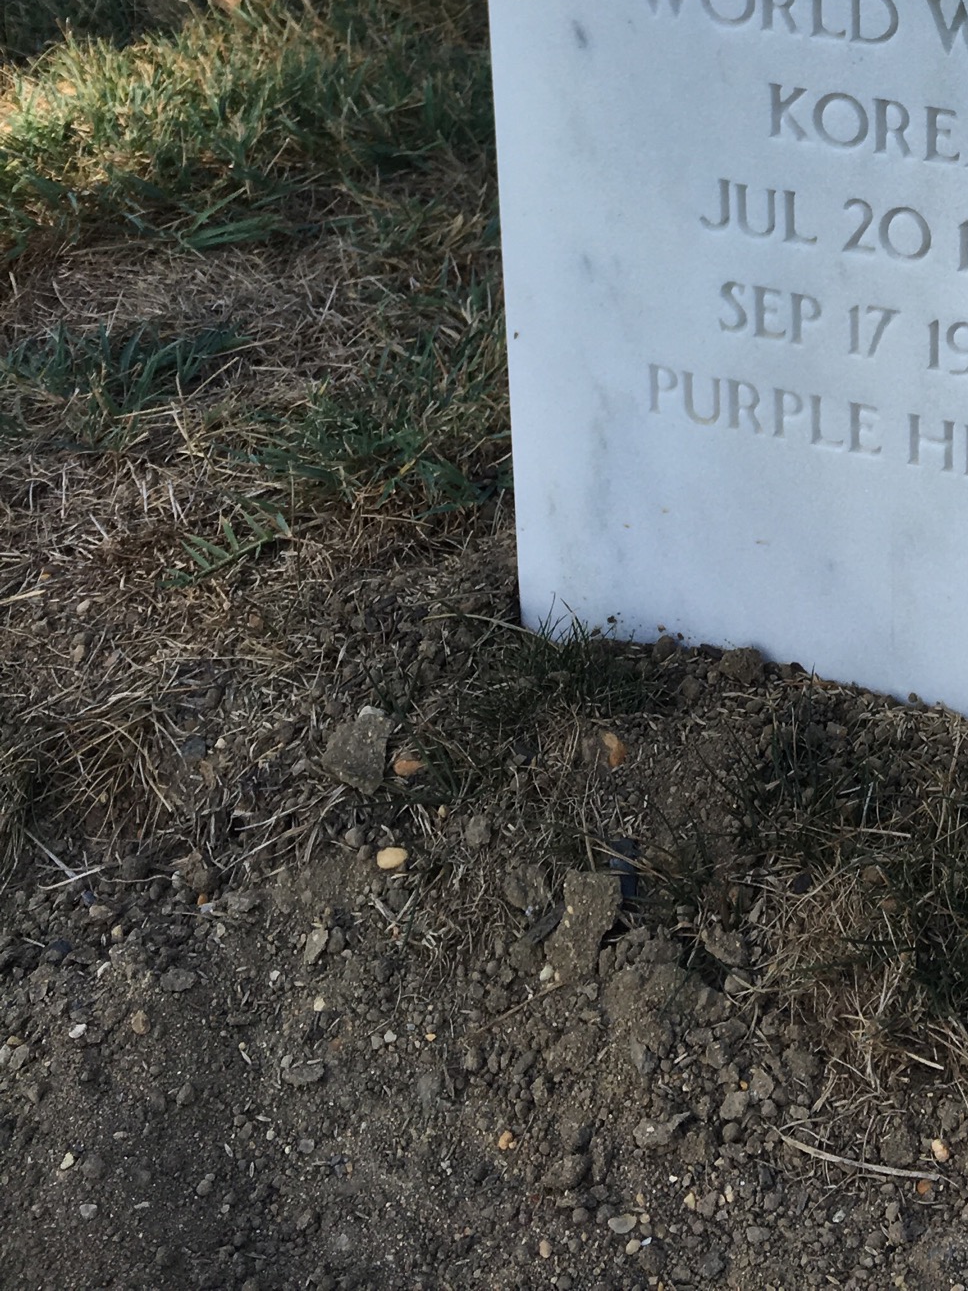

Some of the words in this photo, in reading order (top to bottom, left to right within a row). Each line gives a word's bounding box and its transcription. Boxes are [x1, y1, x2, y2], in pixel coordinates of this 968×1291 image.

[699, 178, 818, 245] JUL
[841, 197, 933, 261] 20
[718, 280, 823, 346] SEP
[847, 304, 901, 358] 17
[646, 362, 883, 456] PURPLE
